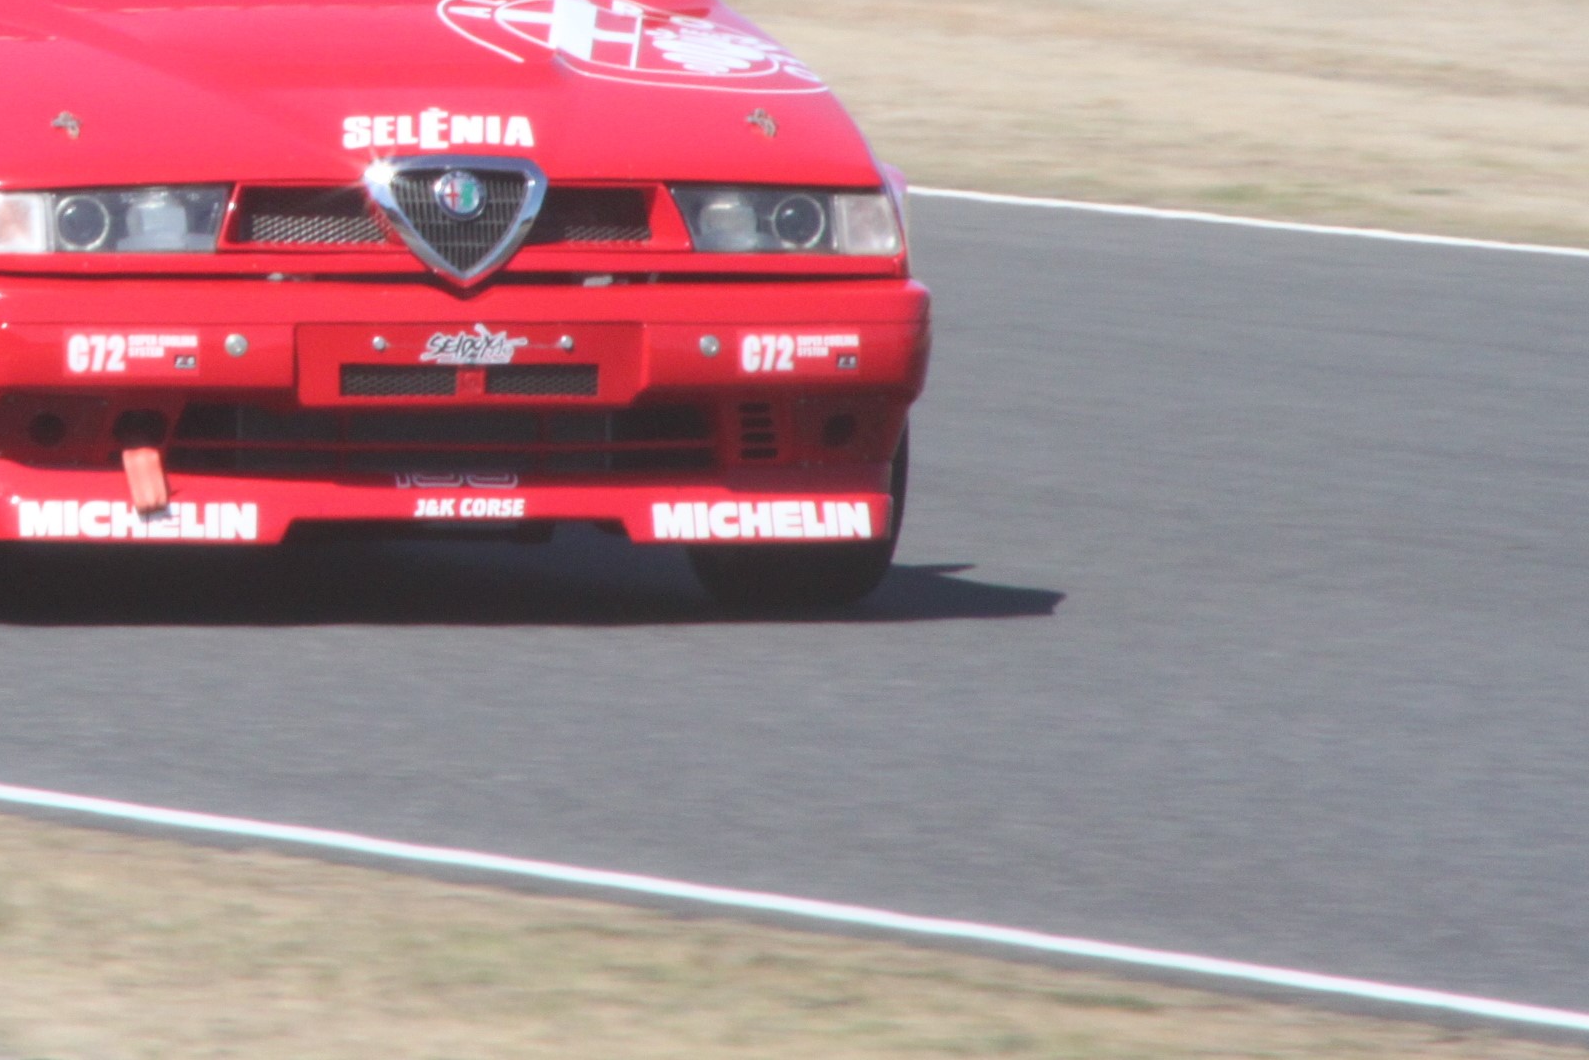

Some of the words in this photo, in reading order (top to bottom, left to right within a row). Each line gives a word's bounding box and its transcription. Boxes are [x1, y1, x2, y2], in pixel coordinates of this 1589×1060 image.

[19, 500, 258, 540] MICHELIN
[414, 498, 456, 517] J&K
[459, 497, 526, 518] CORSE
[651, 500, 872, 540] MICHELIN
